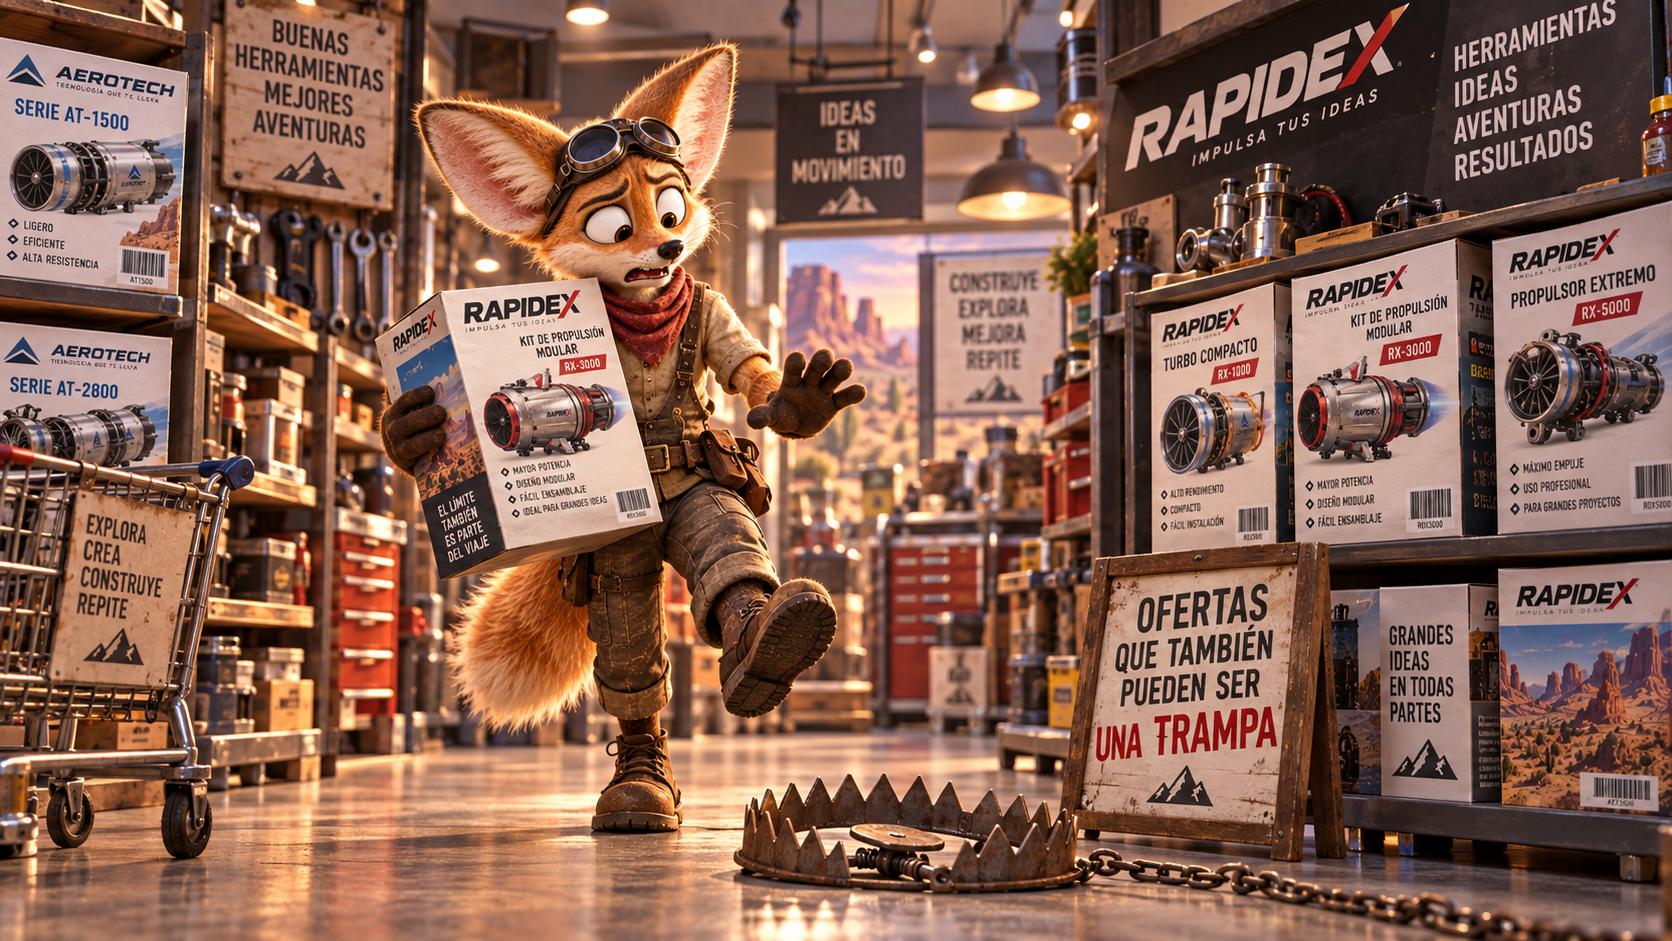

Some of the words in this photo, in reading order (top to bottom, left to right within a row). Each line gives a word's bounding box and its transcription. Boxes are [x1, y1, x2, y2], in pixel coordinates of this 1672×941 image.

[272, 19, 349, 56] BUENAS
[1454, 0, 1617, 72] HERRAMIENTAS
[235, 43, 384, 92] HERRAMIENTAS
[55, 66, 175, 97] AEROTECH
[1124, 2, 1410, 172] RAPIDEX
[1454, 65, 1518, 108] IDEAS
[265, 80, 353, 117] MEJORES
[15, 98, 60, 121] SERIE
[64, 105, 130, 131] AT-1500
[820, 99, 877, 127] IDEAS
[1453, 85, 1582, 145] AVENTURAS
[253, 110, 365, 149] AVENTURAS
[1191, 129, 1266, 167] IMPULSA
[1277, 113, 1310, 136] TUS
[1322, 88, 1379, 121] IDEAS
[836, 129, 860, 154] EN
[1455, 121, 1593, 182] RESULTADOS
[792, 154, 906, 184] MOVIMIENTO
[23, 220, 54, 233] LIGERO
[23, 236, 65, 250] EFICIENTE
[1509, 228, 1621, 274] RAPIDEX
[22, 253, 43, 263] ALTA
[46, 255, 99, 270] RESISTENCIA
[950, 270, 1039, 293] CONSTRUYE
[1305, 264, 1408, 310] RAPIDEX
[1511, 279, 1586, 310] PROPULSOR
[1590, 264, 1656, 294] EXTREMO
[464, 290, 581, 324] RAPIDEX
[958, 297, 1029, 319] EXPLORA
[1351, 312, 1366, 329] KIT
[1370, 309, 1382, 325] DE
[1385, 294, 1448, 321] PROPULSIÓN
[1581, 298, 1631, 320] RX-5000
[393, 310, 437, 352] RAPIDEX
[465, 324, 506, 333] IMPULSA
[519, 335, 535, 347] KIT
[538, 334, 550, 345] DE
[552, 325, 605, 343] PROPULSIÓN
[962, 323, 1027, 345] MEJORA
[1162, 303, 1244, 342] RAPIDEX
[1366, 320, 1413, 341] MODULAR
[51, 344, 151, 364] AEROTECH
[536, 343, 579, 359] MOULAR
[966, 350, 1022, 370] REPITE
[1163, 352, 1197, 372] TURBO
[1200, 337, 1258, 364] COMPACTO
[1388, 341, 1432, 361] RX-3000
[1218, 363, 1251, 381] RX-1000
[10, 376, 52, 395] SERIE
[57, 380, 118, 399] AT-2800
[513, 464, 536, 475] MAYOR
[1523, 460, 1552, 474] MÁXIMO
[1554, 457, 1585, 471] EMPUJE
[516, 476, 541, 489] DISEÑO
[543, 472, 575, 484] MODULAR
[520, 491, 540, 502] FÁCIL
[541, 485, 587, 499] ENSAMBLAJE
[1317, 479, 1340, 490] MAYOR
[1341, 475, 1374, 488] POTENCIA
[1523, 482, 1538, 494] USO
[1541, 478, 1592, 493] PROFESIONAL
[438, 504, 449, 517] EL
[449, 490, 476, 513] LÍMITE
[523, 506, 542, 516] IDEAL
[543, 503, 560, 513] PARA
[589, 496, 607, 506] IDEAS
[1317, 496, 1341, 509] DISEÑO
[1342, 494, 1375, 506] MODULAR
[1523, 502, 1542, 514] PARA
[1544, 499, 1577, 512] GRANDES
[1579, 496, 1621, 510] PROYECTOS
[85, 513, 147, 545] EXPLORA
[441, 506, 478, 532] TAMBIÉN
[1318, 515, 1336, 528] FÁCIL
[1338, 512, 1382, 526] ENSAMBLAJE
[445, 533, 456, 547] ES
[457, 520, 484, 542] PARTE
[83, 539, 121, 566] CREA
[447, 547, 464, 563] DEL
[464, 534, 490, 555] VIAJE
[80, 566, 163, 598] CONSTRUYE
[1516, 578, 1640, 610] RAPIDEX
[76, 593, 129, 620] REPITE
[1136, 583, 1269, 634] OFERTAS
[1389, 624, 1454, 646] GRANDES
[1115, 640, 1159, 674] QUE
[1168, 624, 1274, 668] TAMBIÉN
[1389, 650, 1430, 672] IDEAS
[1120, 672, 1206, 707] PUEDEN
[1215, 668, 1260, 700] SER
[1389, 676, 1407, 697] EN
[1411, 676, 1454, 697] TODAS
[1390, 701, 1442, 724] PARTES
[1095, 723, 1143, 762] UNA
[1154, 706, 1278, 756] TRAMPA
